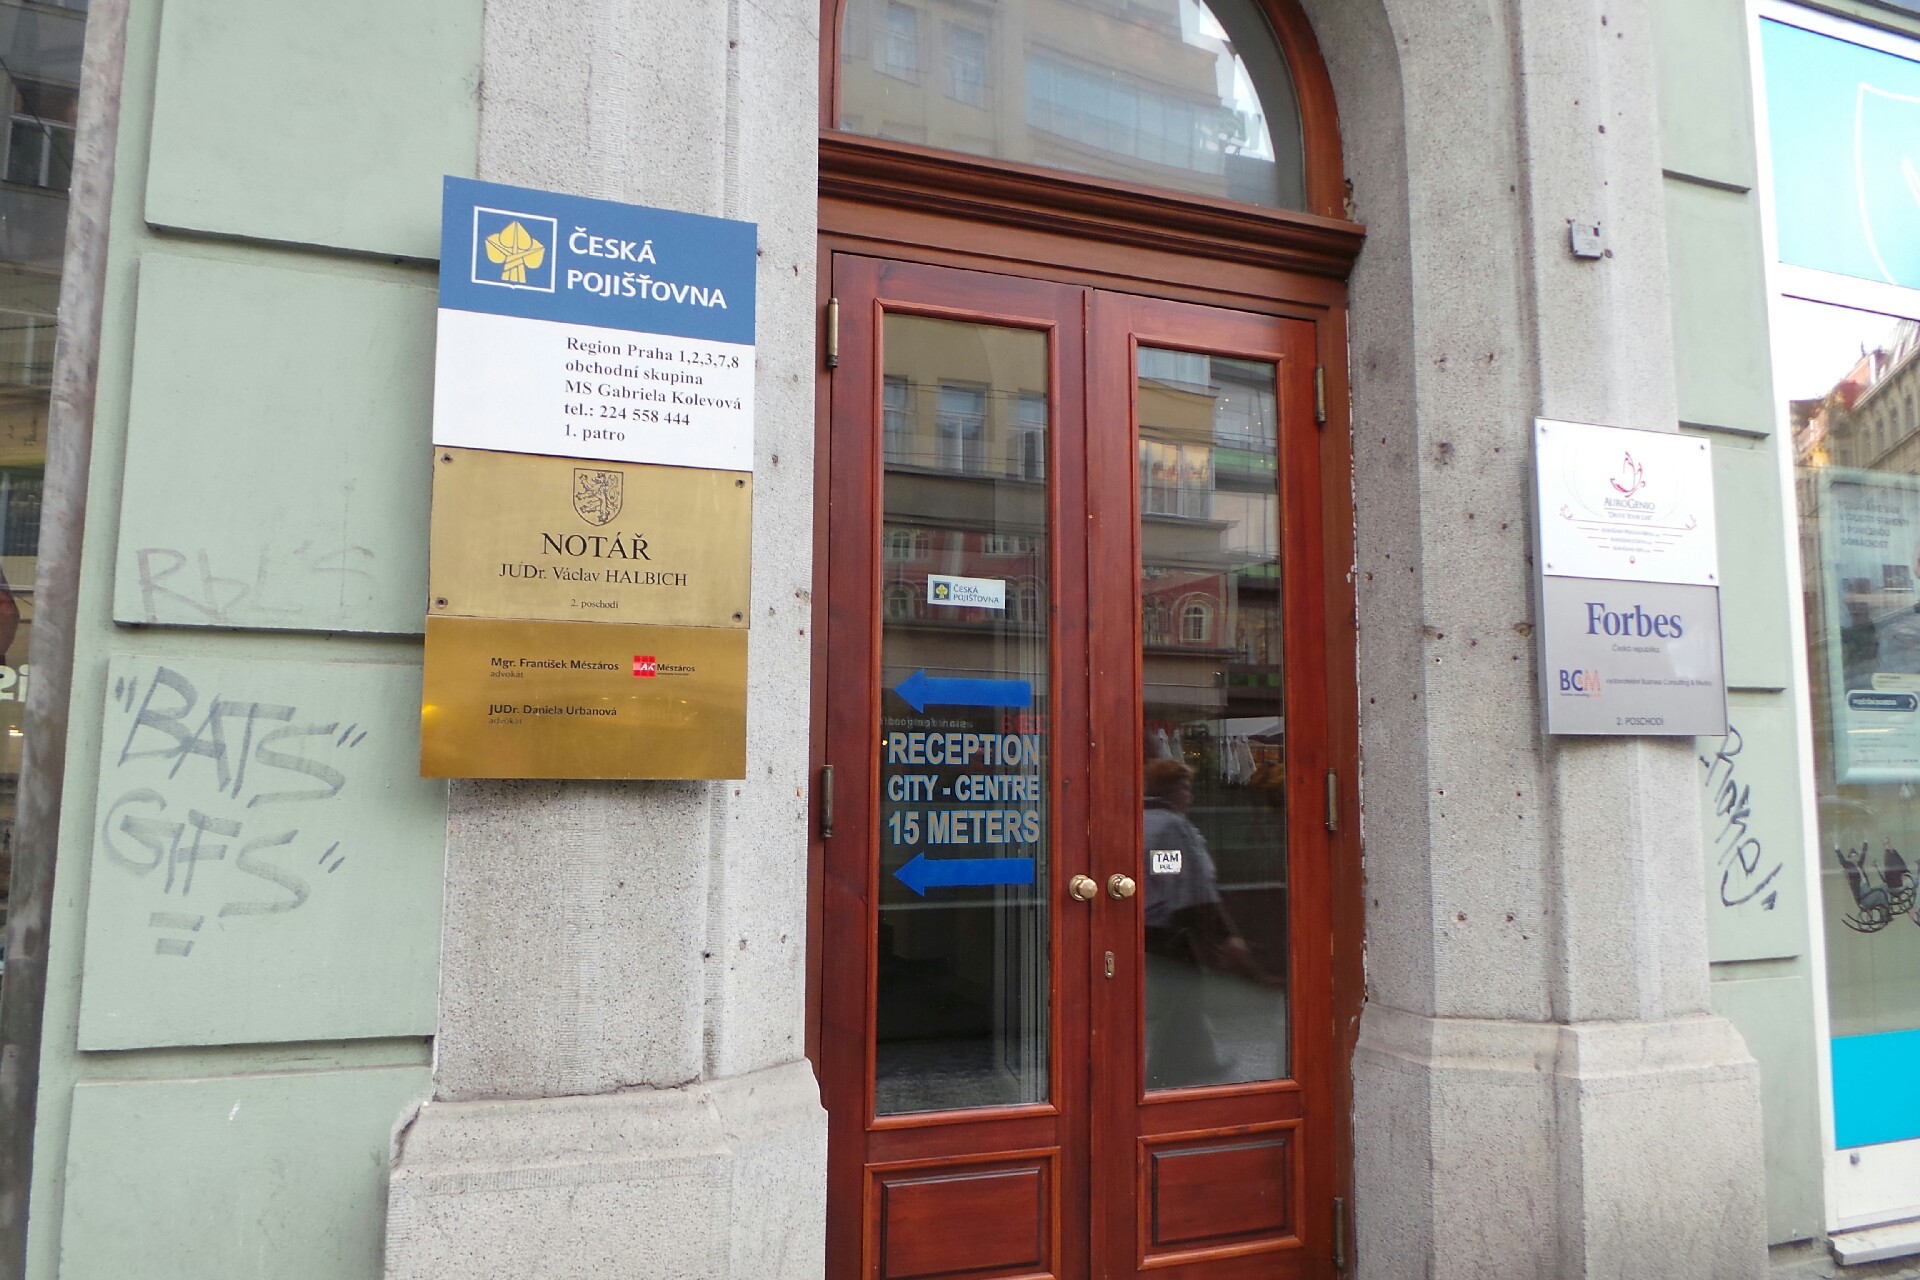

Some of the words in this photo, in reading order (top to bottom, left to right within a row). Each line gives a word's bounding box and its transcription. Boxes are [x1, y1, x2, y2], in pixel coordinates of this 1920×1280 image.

[568, 226, 657, 265] ČESKÁ
[567, 268, 728, 310] POJIŠŤOVNA
[566, 336, 622, 356] Region
[627, 343, 674, 362] Praha
[678, 349, 740, 370] 1,2,3,7,8
[565, 359, 639, 379] obchodní
[643, 366, 703, 386] skupina
[564, 379, 593, 395] MS
[598, 383, 667, 403] Gabriela
[671, 391, 742, 411] Kolevová
[564, 403, 594, 417] tel.:
[599, 405, 627, 421] 224
[632, 407, 660, 424] 558
[663, 410, 691, 427] 444
[564, 424, 577, 438] 1.
[582, 425, 626, 443] patro
[540, 531, 652, 561] NOTÁŘ
[498, 562, 547, 580] JUDr.
[552, 566, 600, 583] Václav
[605, 569, 688, 587] HALBICH
[953, 584, 979, 594] ČESKÁ
[953, 593, 1000, 604] POJIŠŤOVNA
[571, 598, 579, 608] 2.
[580, 599, 619, 611] poschodí
[1585, 602, 1684, 639] Forbes
[490, 657, 517, 669] Mgr.
[519, 658, 568, 670] František
[570, 660, 620, 672] Mészáros
[640, 662, 655, 671] AK
[656, 663, 696, 673] Mészáros
[488, 703, 520, 716] JUDr.
[523, 704, 563, 716] Daniela
[566, 704, 617, 717] Urbanová
[888, 731, 1040, 766] RECEPTION
[887, 774, 939, 802] CITY
[954, 774, 1040, 802] CENTRE
[888, 810, 920, 844] 15
[927, 809, 1040, 844] METERS
[1156, 852, 1179, 863] TAM
